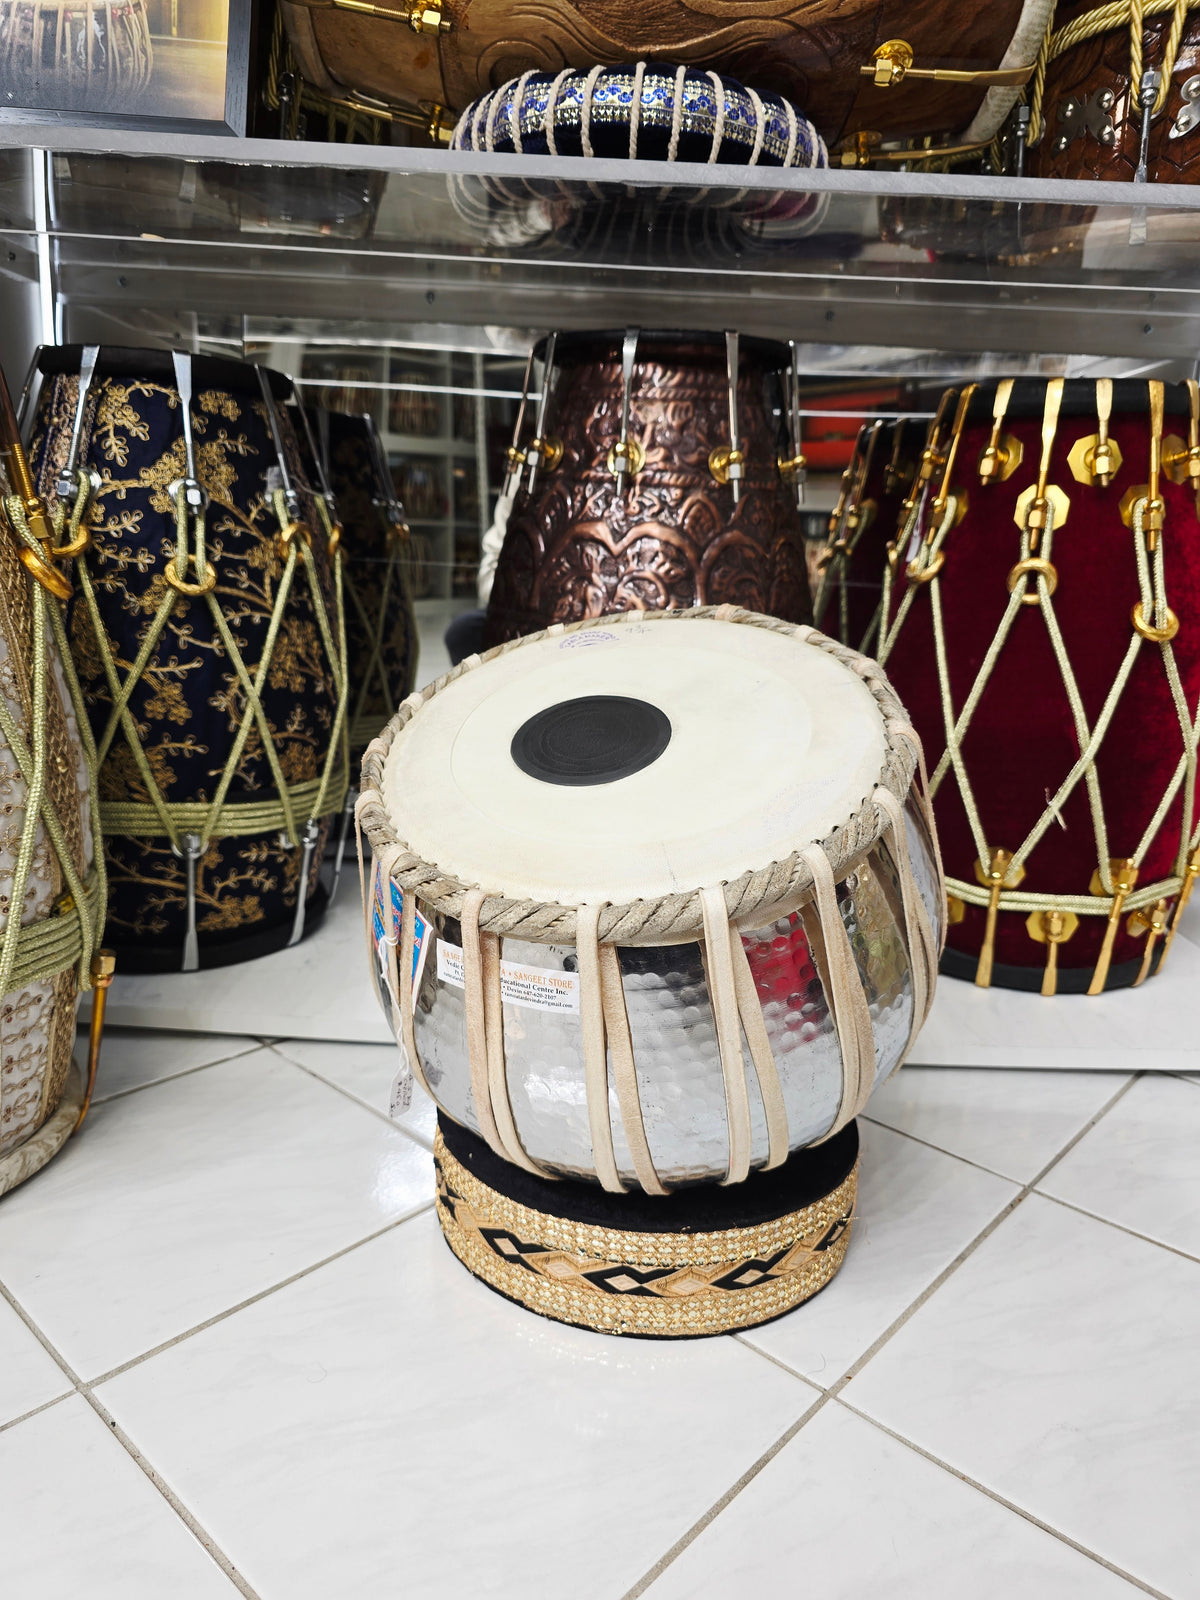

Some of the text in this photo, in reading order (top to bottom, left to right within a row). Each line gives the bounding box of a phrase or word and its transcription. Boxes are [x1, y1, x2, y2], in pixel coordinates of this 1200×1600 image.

[446, 958, 461, 970] Vedic
[513, 971, 547, 986] SANGEET
[548, 978, 574, 990] STORE
[506, 985, 523, 995] Devin
[532, 983, 555, 994] Centre
[555, 988, 569, 997] Inc.
